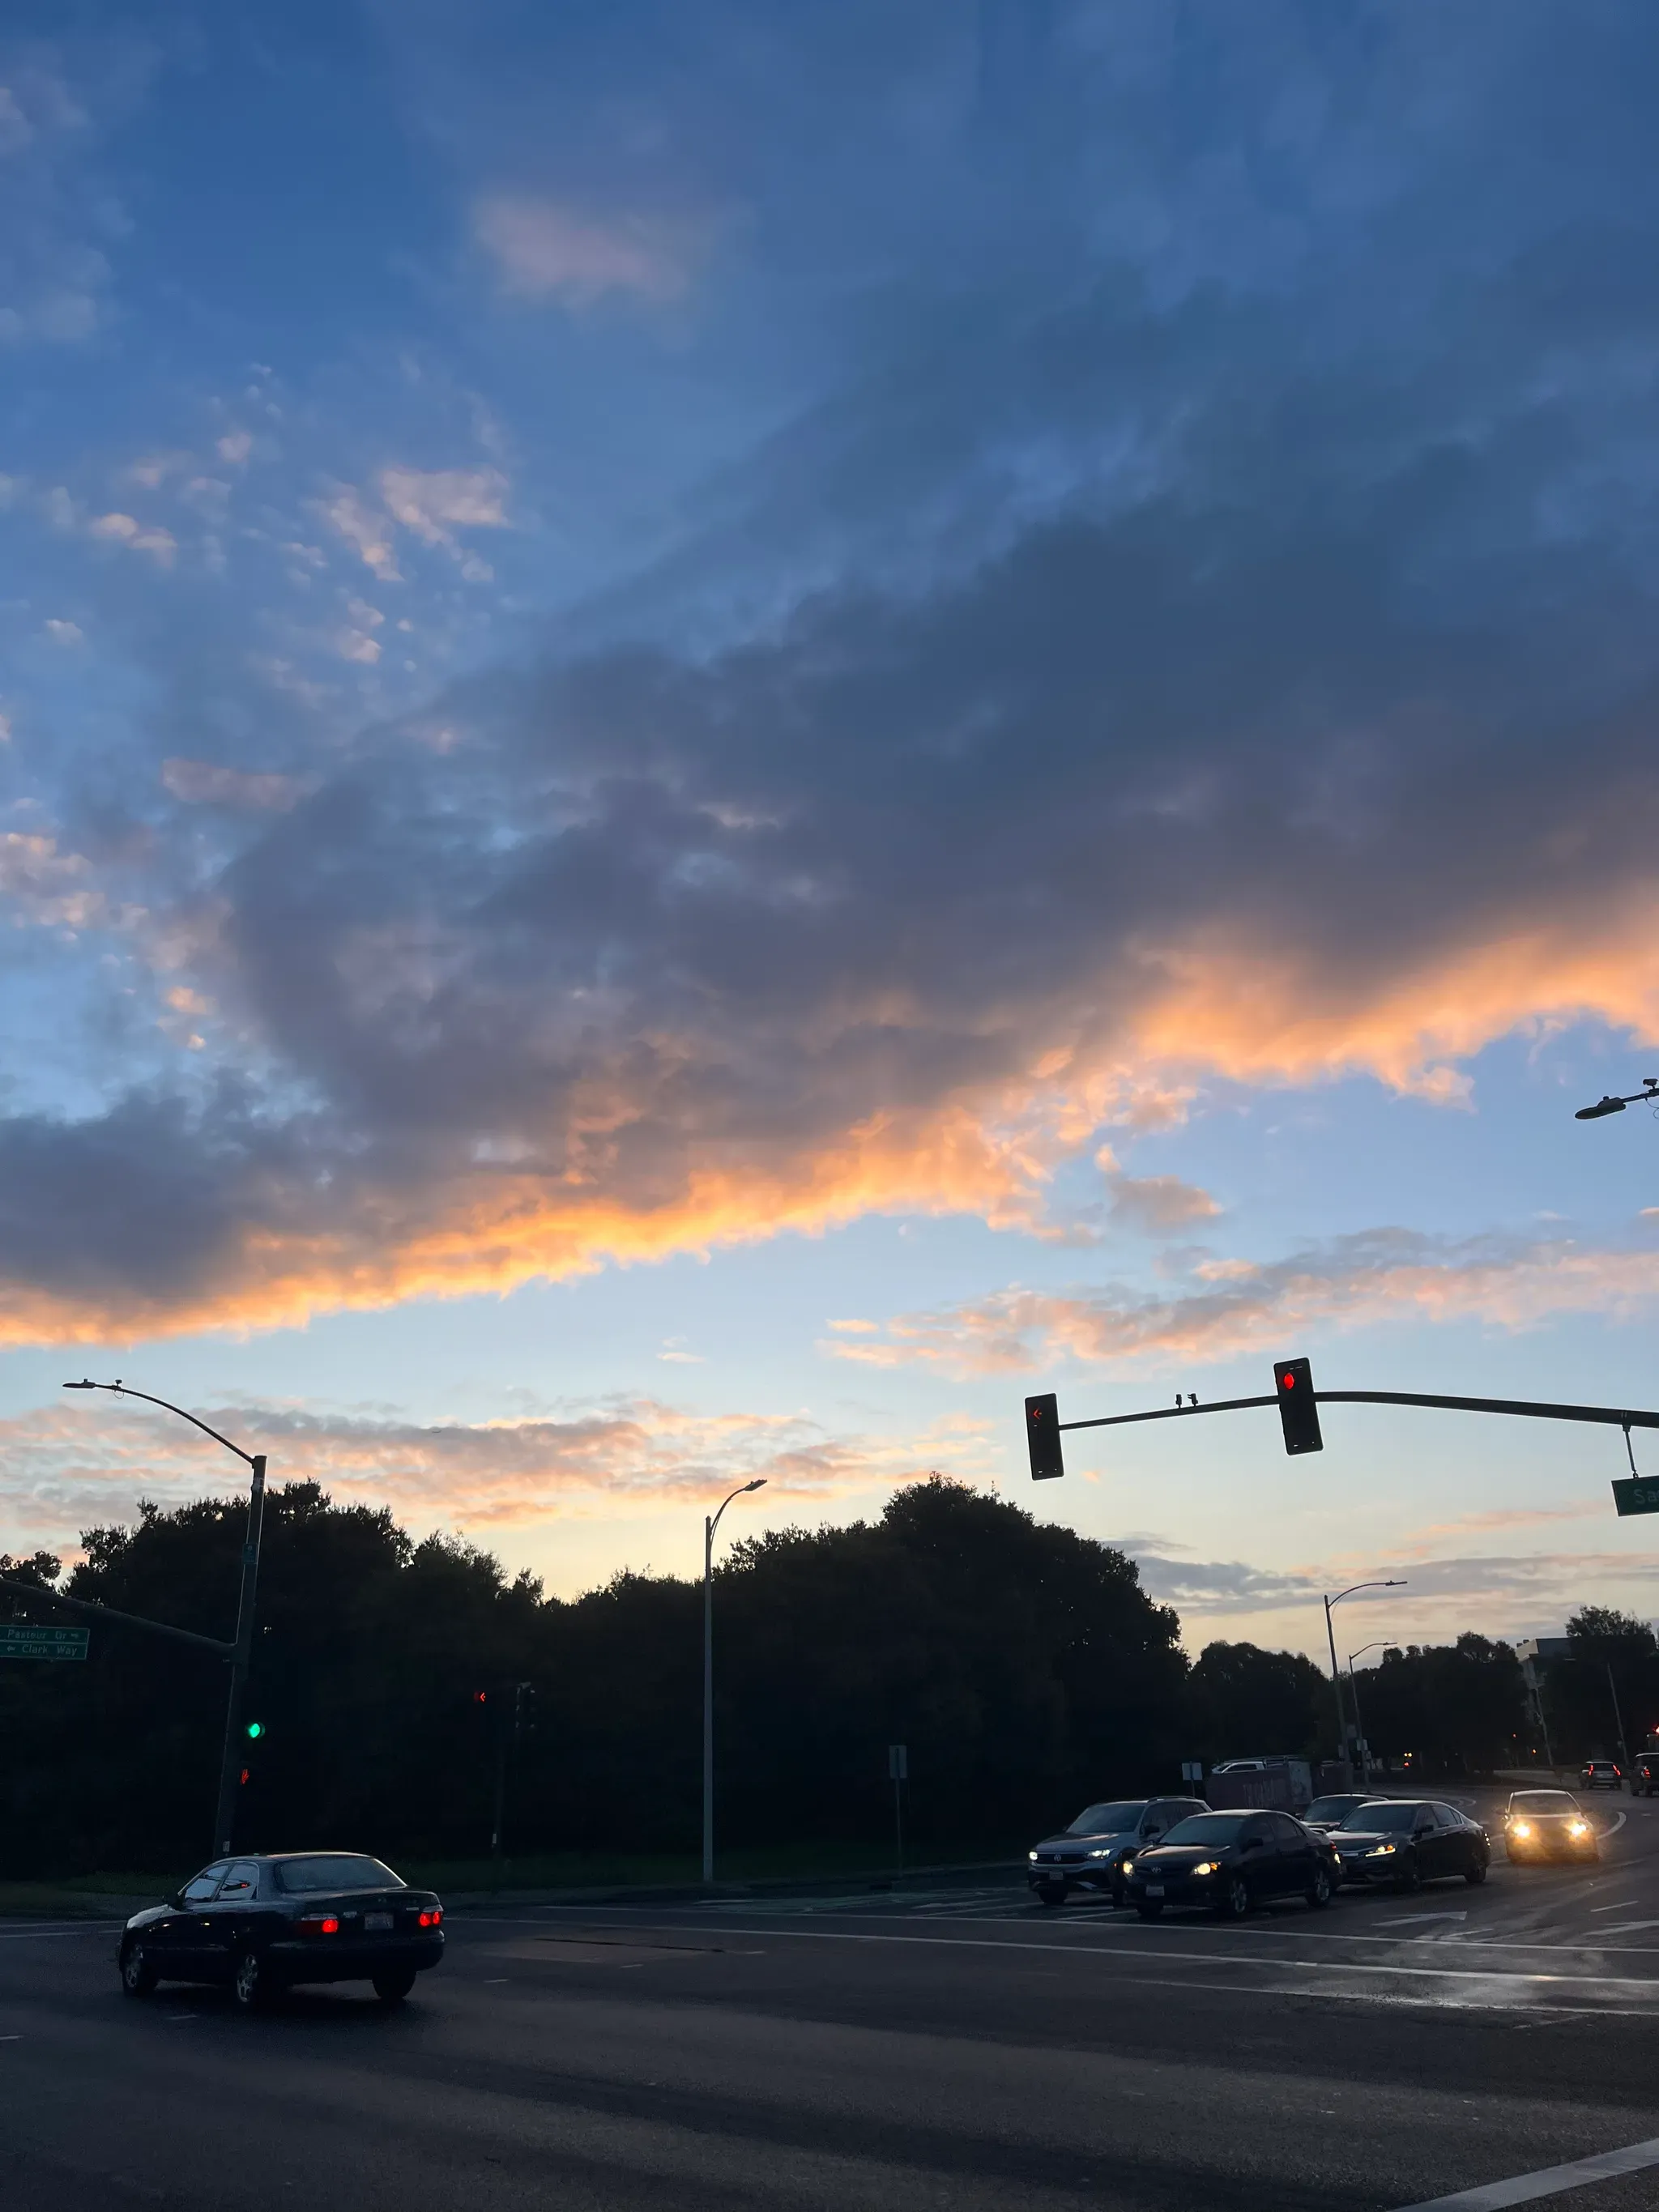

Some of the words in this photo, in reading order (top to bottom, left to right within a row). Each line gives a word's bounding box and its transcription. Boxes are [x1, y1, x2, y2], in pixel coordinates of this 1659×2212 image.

[1633, 1489, 1659, 1505] Sa
[55, 1630, 67, 1640] Dr
[22, 1643, 49, 1654] Clark
[57, 1645, 77, 1657] Way
